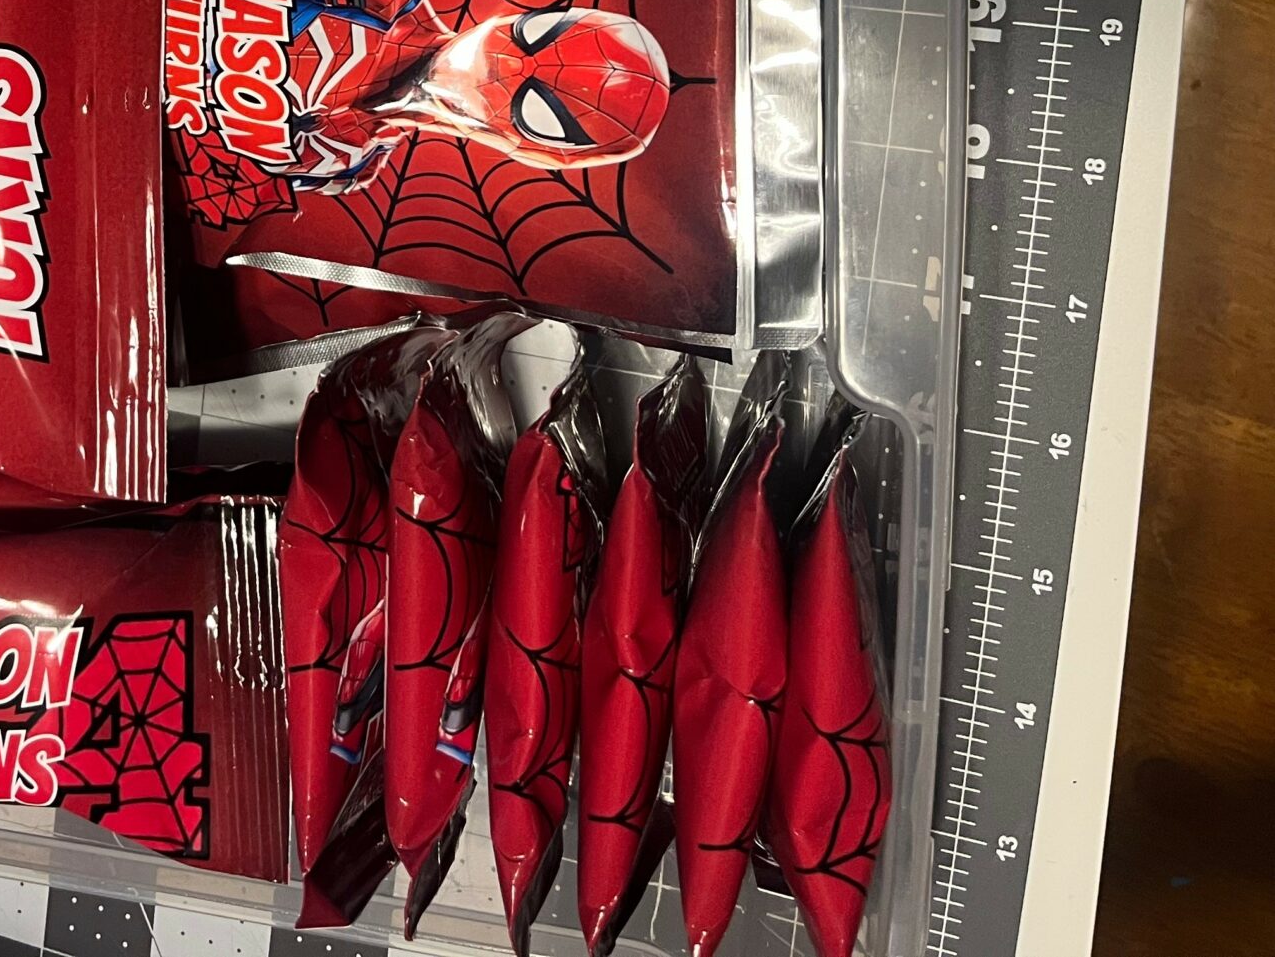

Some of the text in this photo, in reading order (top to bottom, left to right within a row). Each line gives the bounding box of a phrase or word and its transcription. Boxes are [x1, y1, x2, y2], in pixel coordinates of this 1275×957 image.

[1099, 18, 1123, 46] 19
[1082, 157, 1106, 185] 18
[1065, 294, 1088, 323] 17
[1048, 432, 1072, 460] 16
[1032, 568, 1054, 595] 15
[1014, 702, 1037, 730] 14
[996, 835, 1018, 861] 13
